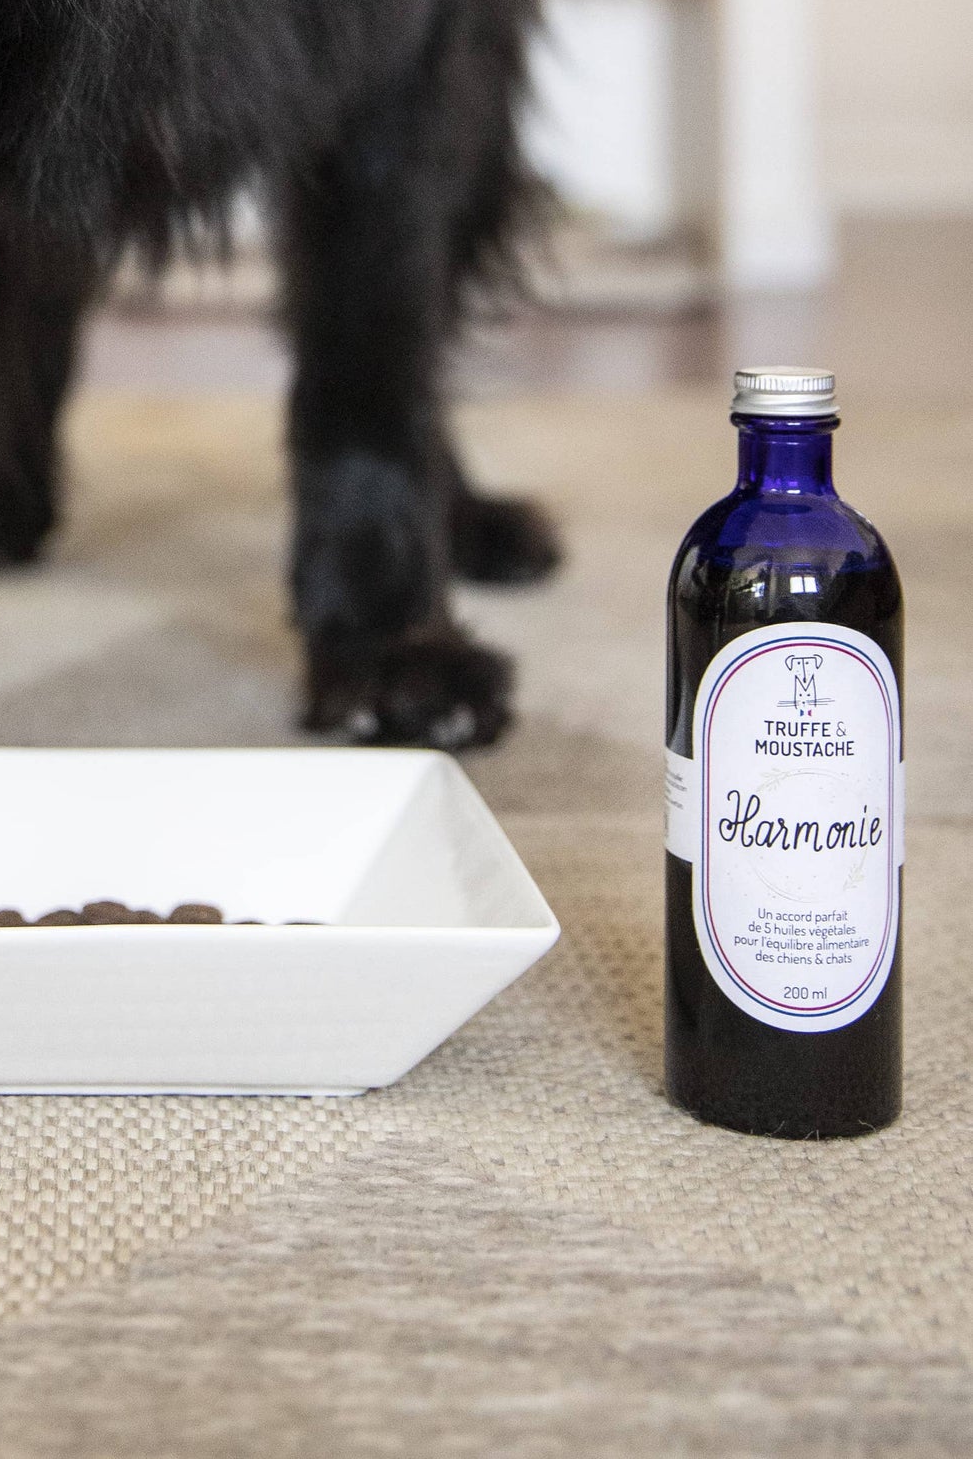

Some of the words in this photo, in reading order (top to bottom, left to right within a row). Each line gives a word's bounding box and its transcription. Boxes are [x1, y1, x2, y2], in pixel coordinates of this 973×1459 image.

[764, 721, 831, 737] TRUFFE
[836, 721, 846, 736] &
[755, 740, 855, 757] MOUSTACHE
[719, 790, 882, 852] Harmonie
[758, 908, 773, 920] Un
[775, 911, 812, 922] accord
[815, 910, 848, 924] parfait
[748, 921, 761, 932] de
[764, 922, 771, 934] 5
[774, 924, 806, 936] huiles
[809, 924, 856, 939] végétales
[734, 936, 758, 946] pour
[762, 936, 814, 951] l'équilibre
[816, 938, 870, 950] alimentaire
[755, 950, 774, 962] des
[777, 952, 812, 964] chiens
[815, 953, 823, 964] &
[826, 953, 852, 964] chats
[784, 987, 808, 999] 200
[812, 987, 827, 999] ml
